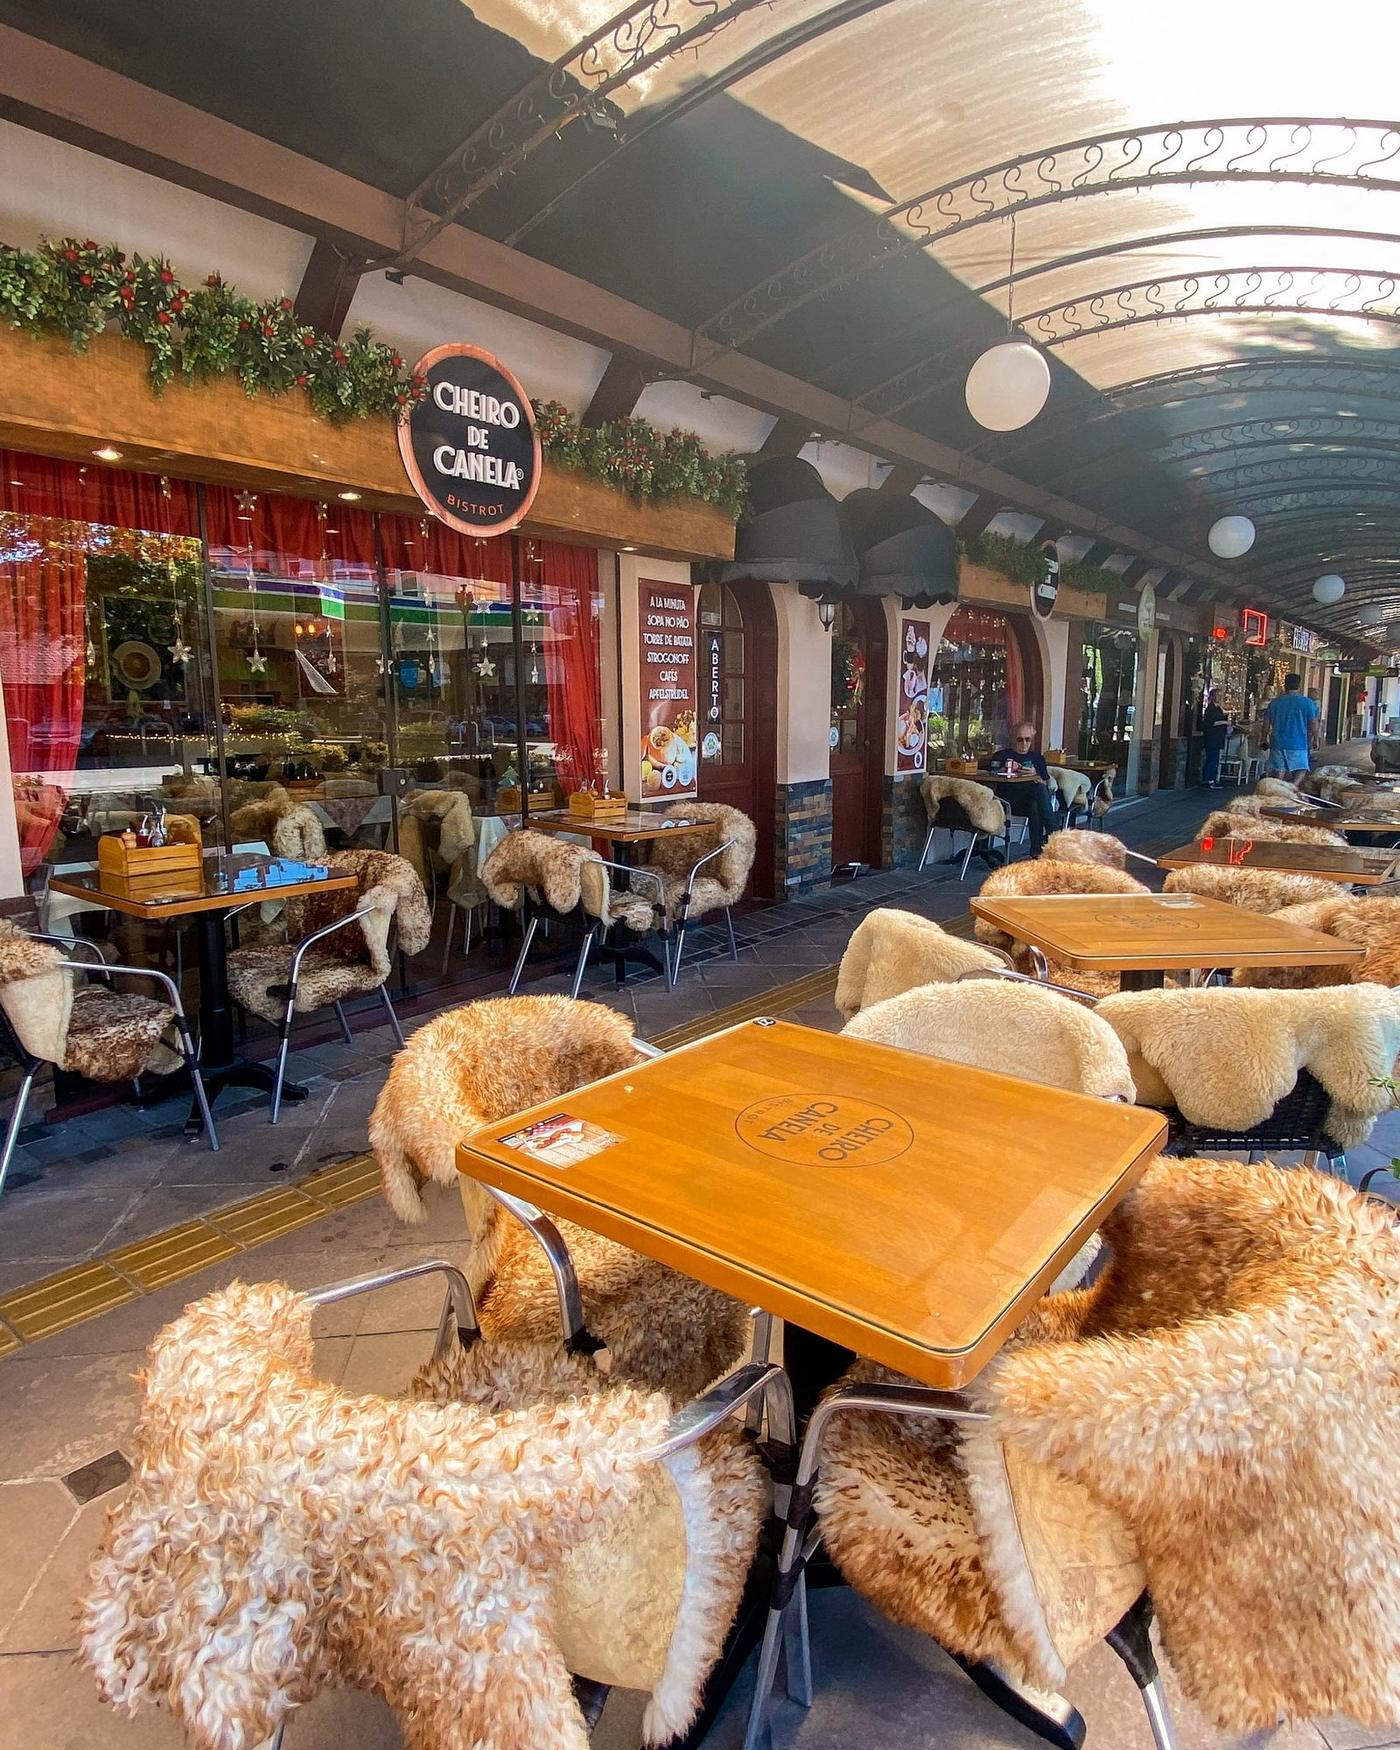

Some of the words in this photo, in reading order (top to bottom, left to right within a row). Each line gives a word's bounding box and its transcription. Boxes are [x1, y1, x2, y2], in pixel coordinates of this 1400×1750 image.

[433, 382, 520, 429] CHEIRO
[467, 425, 489, 450] DE
[447, 494, 504, 516] BISTROT
[656, 597, 663, 608] LA
[664, 598, 686, 611] MINUTA
[647, 614, 664, 627] SOPA
[665, 616, 675, 628] NO
[643, 633, 663, 645] TORRE
[664, 634, 673, 646] DE
[674, 635, 693, 647] BATATA
[647, 652, 690, 664] STROGONOFF
[711, 638, 720, 719] ABERTO
[649, 688, 689, 700] APFELSTRUDEL
[757, 1102, 839, 1142] CANELA
[814, 1123, 841, 1137] DE
[818, 1118, 894, 1161] CHEIRO
